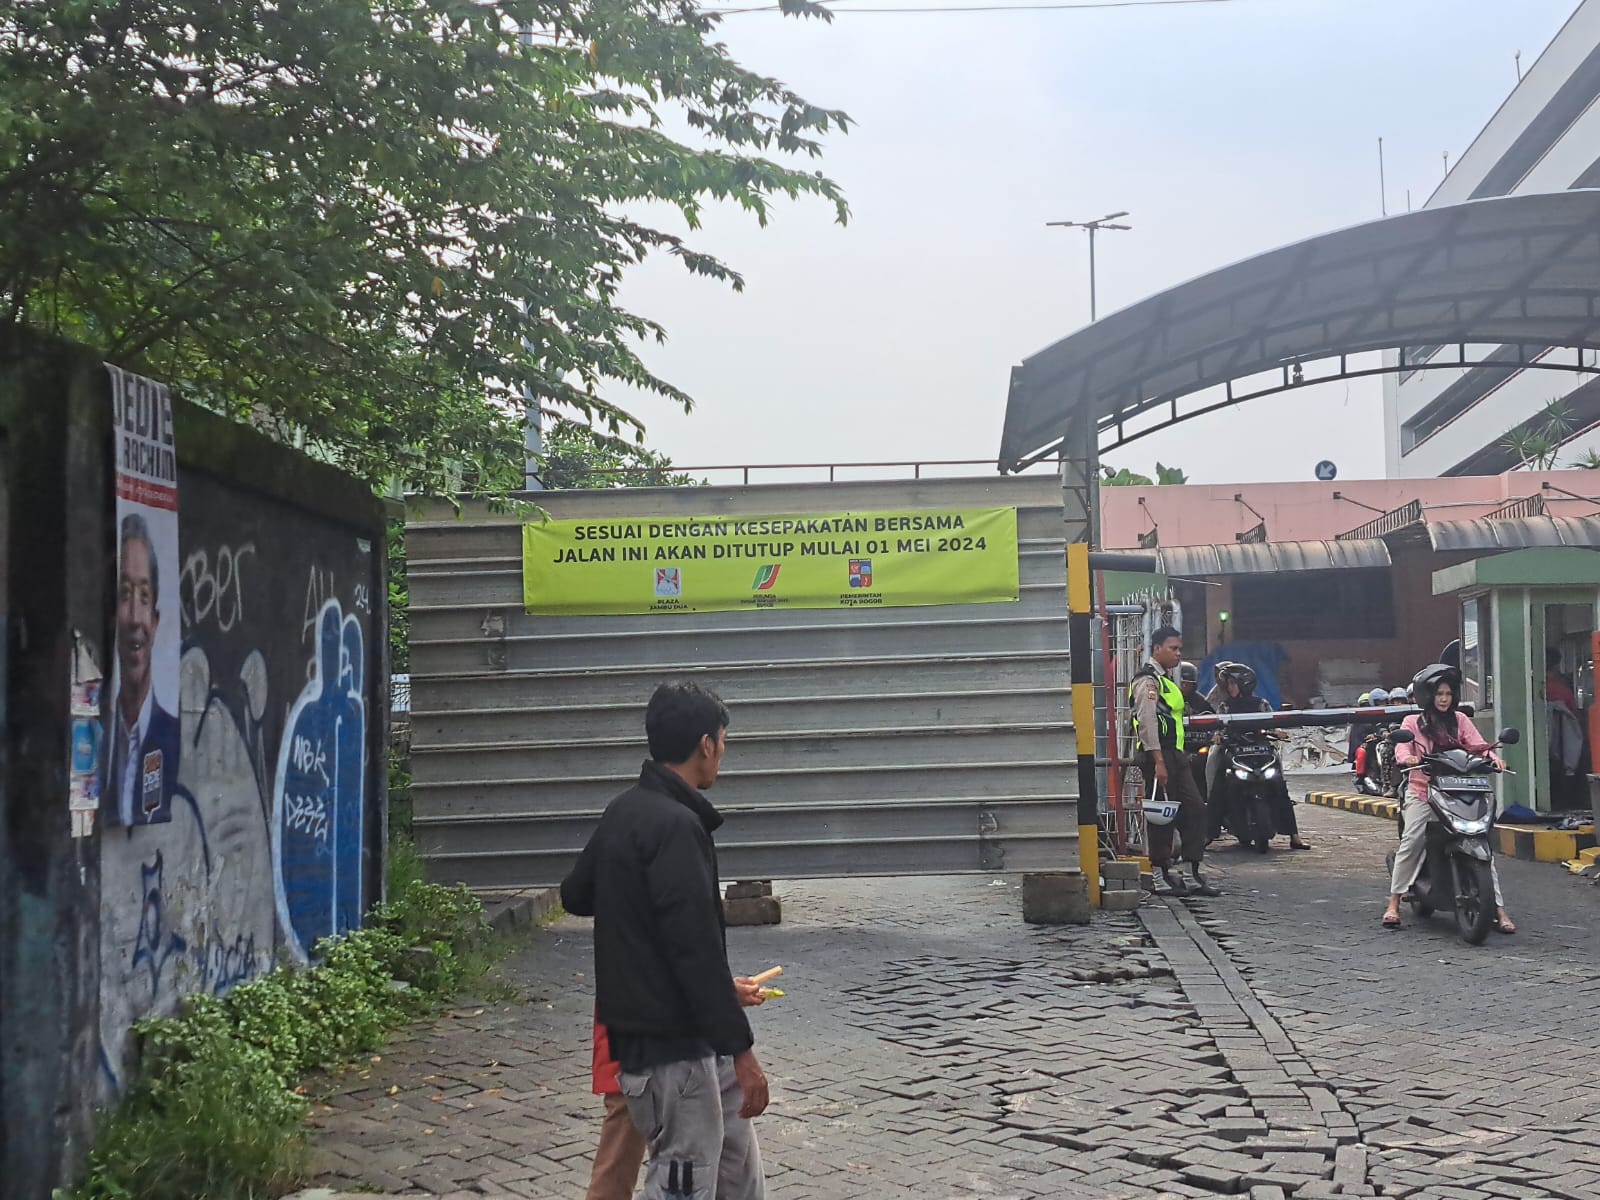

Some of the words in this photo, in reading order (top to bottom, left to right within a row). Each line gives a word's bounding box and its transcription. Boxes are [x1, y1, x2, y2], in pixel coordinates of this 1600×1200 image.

[574, 525, 642, 541] SESUAI
[649, 522, 731, 539] DENGAN
[734, 517, 868, 536] KESEPAKATAN
[874, 515, 965, 532] BERSAMA
[553, 547, 615, 564] JALAN
[622, 546, 648, 562] INI
[654, 544, 706, 560] AKAN
[713, 542, 795, 559] DITUTUP
[800, 540, 860, 556] MULAI
[866, 539, 890, 554] 01
[897, 538, 931, 553] MEI
[937, 536, 987, 552] 2024
